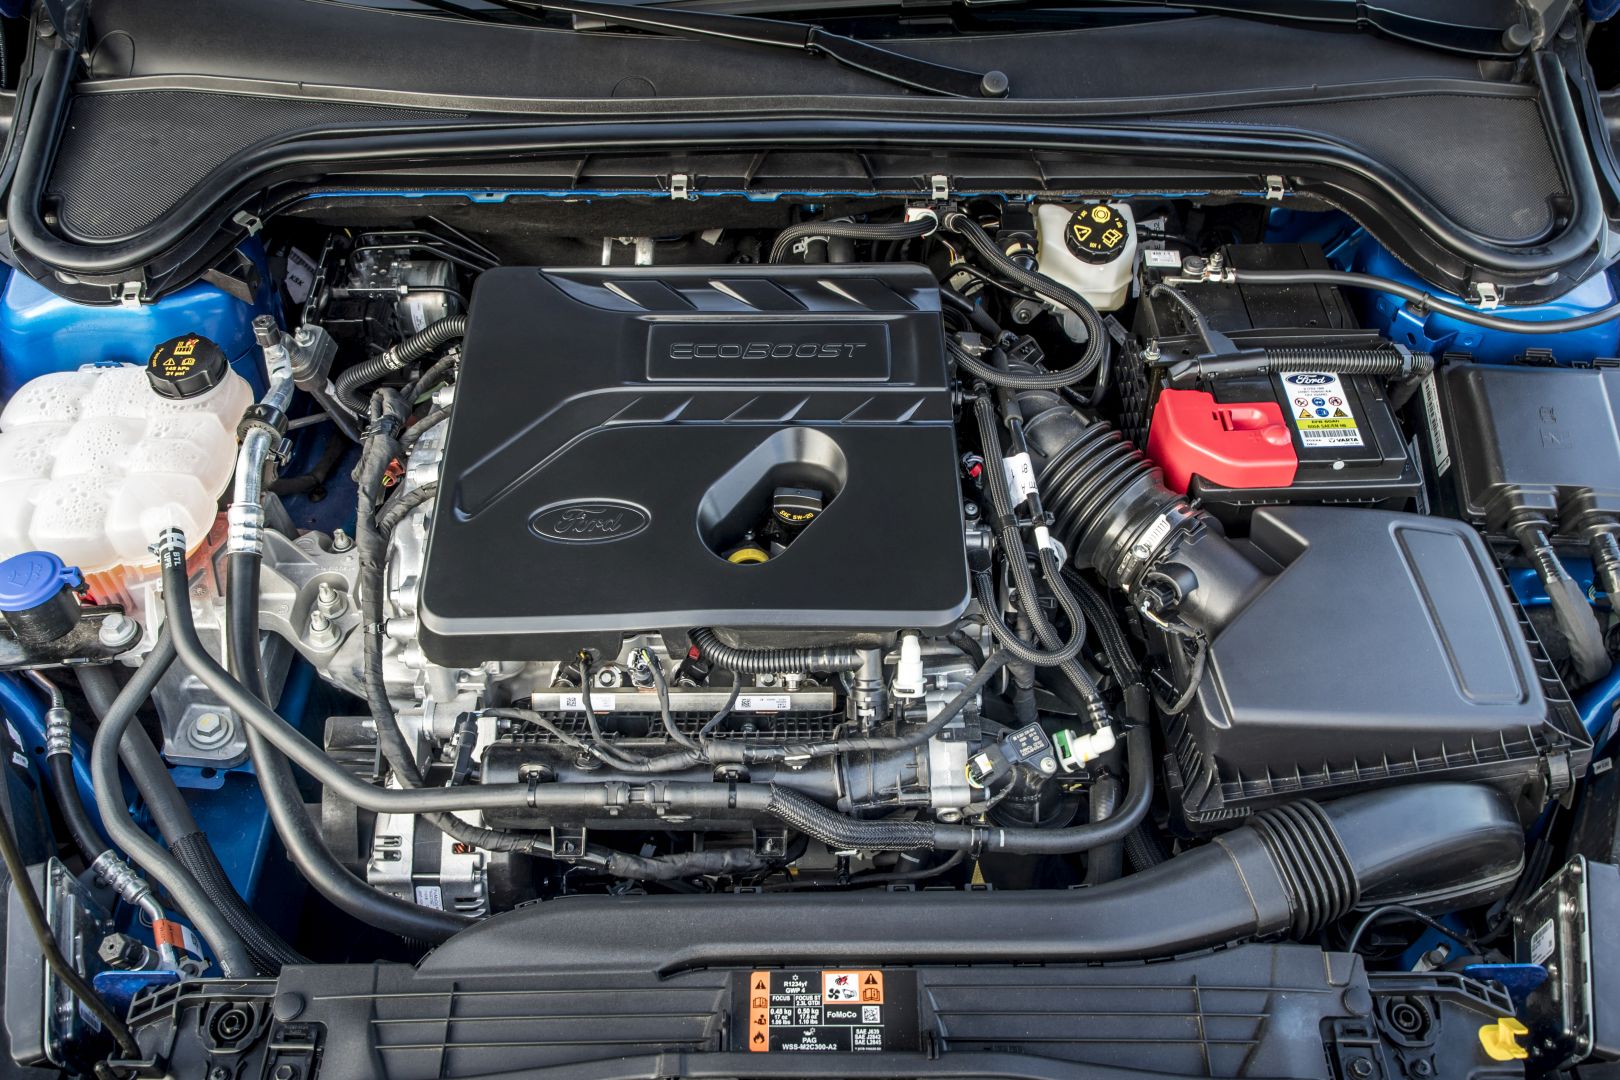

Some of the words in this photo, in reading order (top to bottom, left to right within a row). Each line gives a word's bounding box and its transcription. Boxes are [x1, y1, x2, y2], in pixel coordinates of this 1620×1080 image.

[1296, 374, 1326, 384] Ford
[554, 508, 624, 533] Ford
[172, 552, 182, 566] BTL
